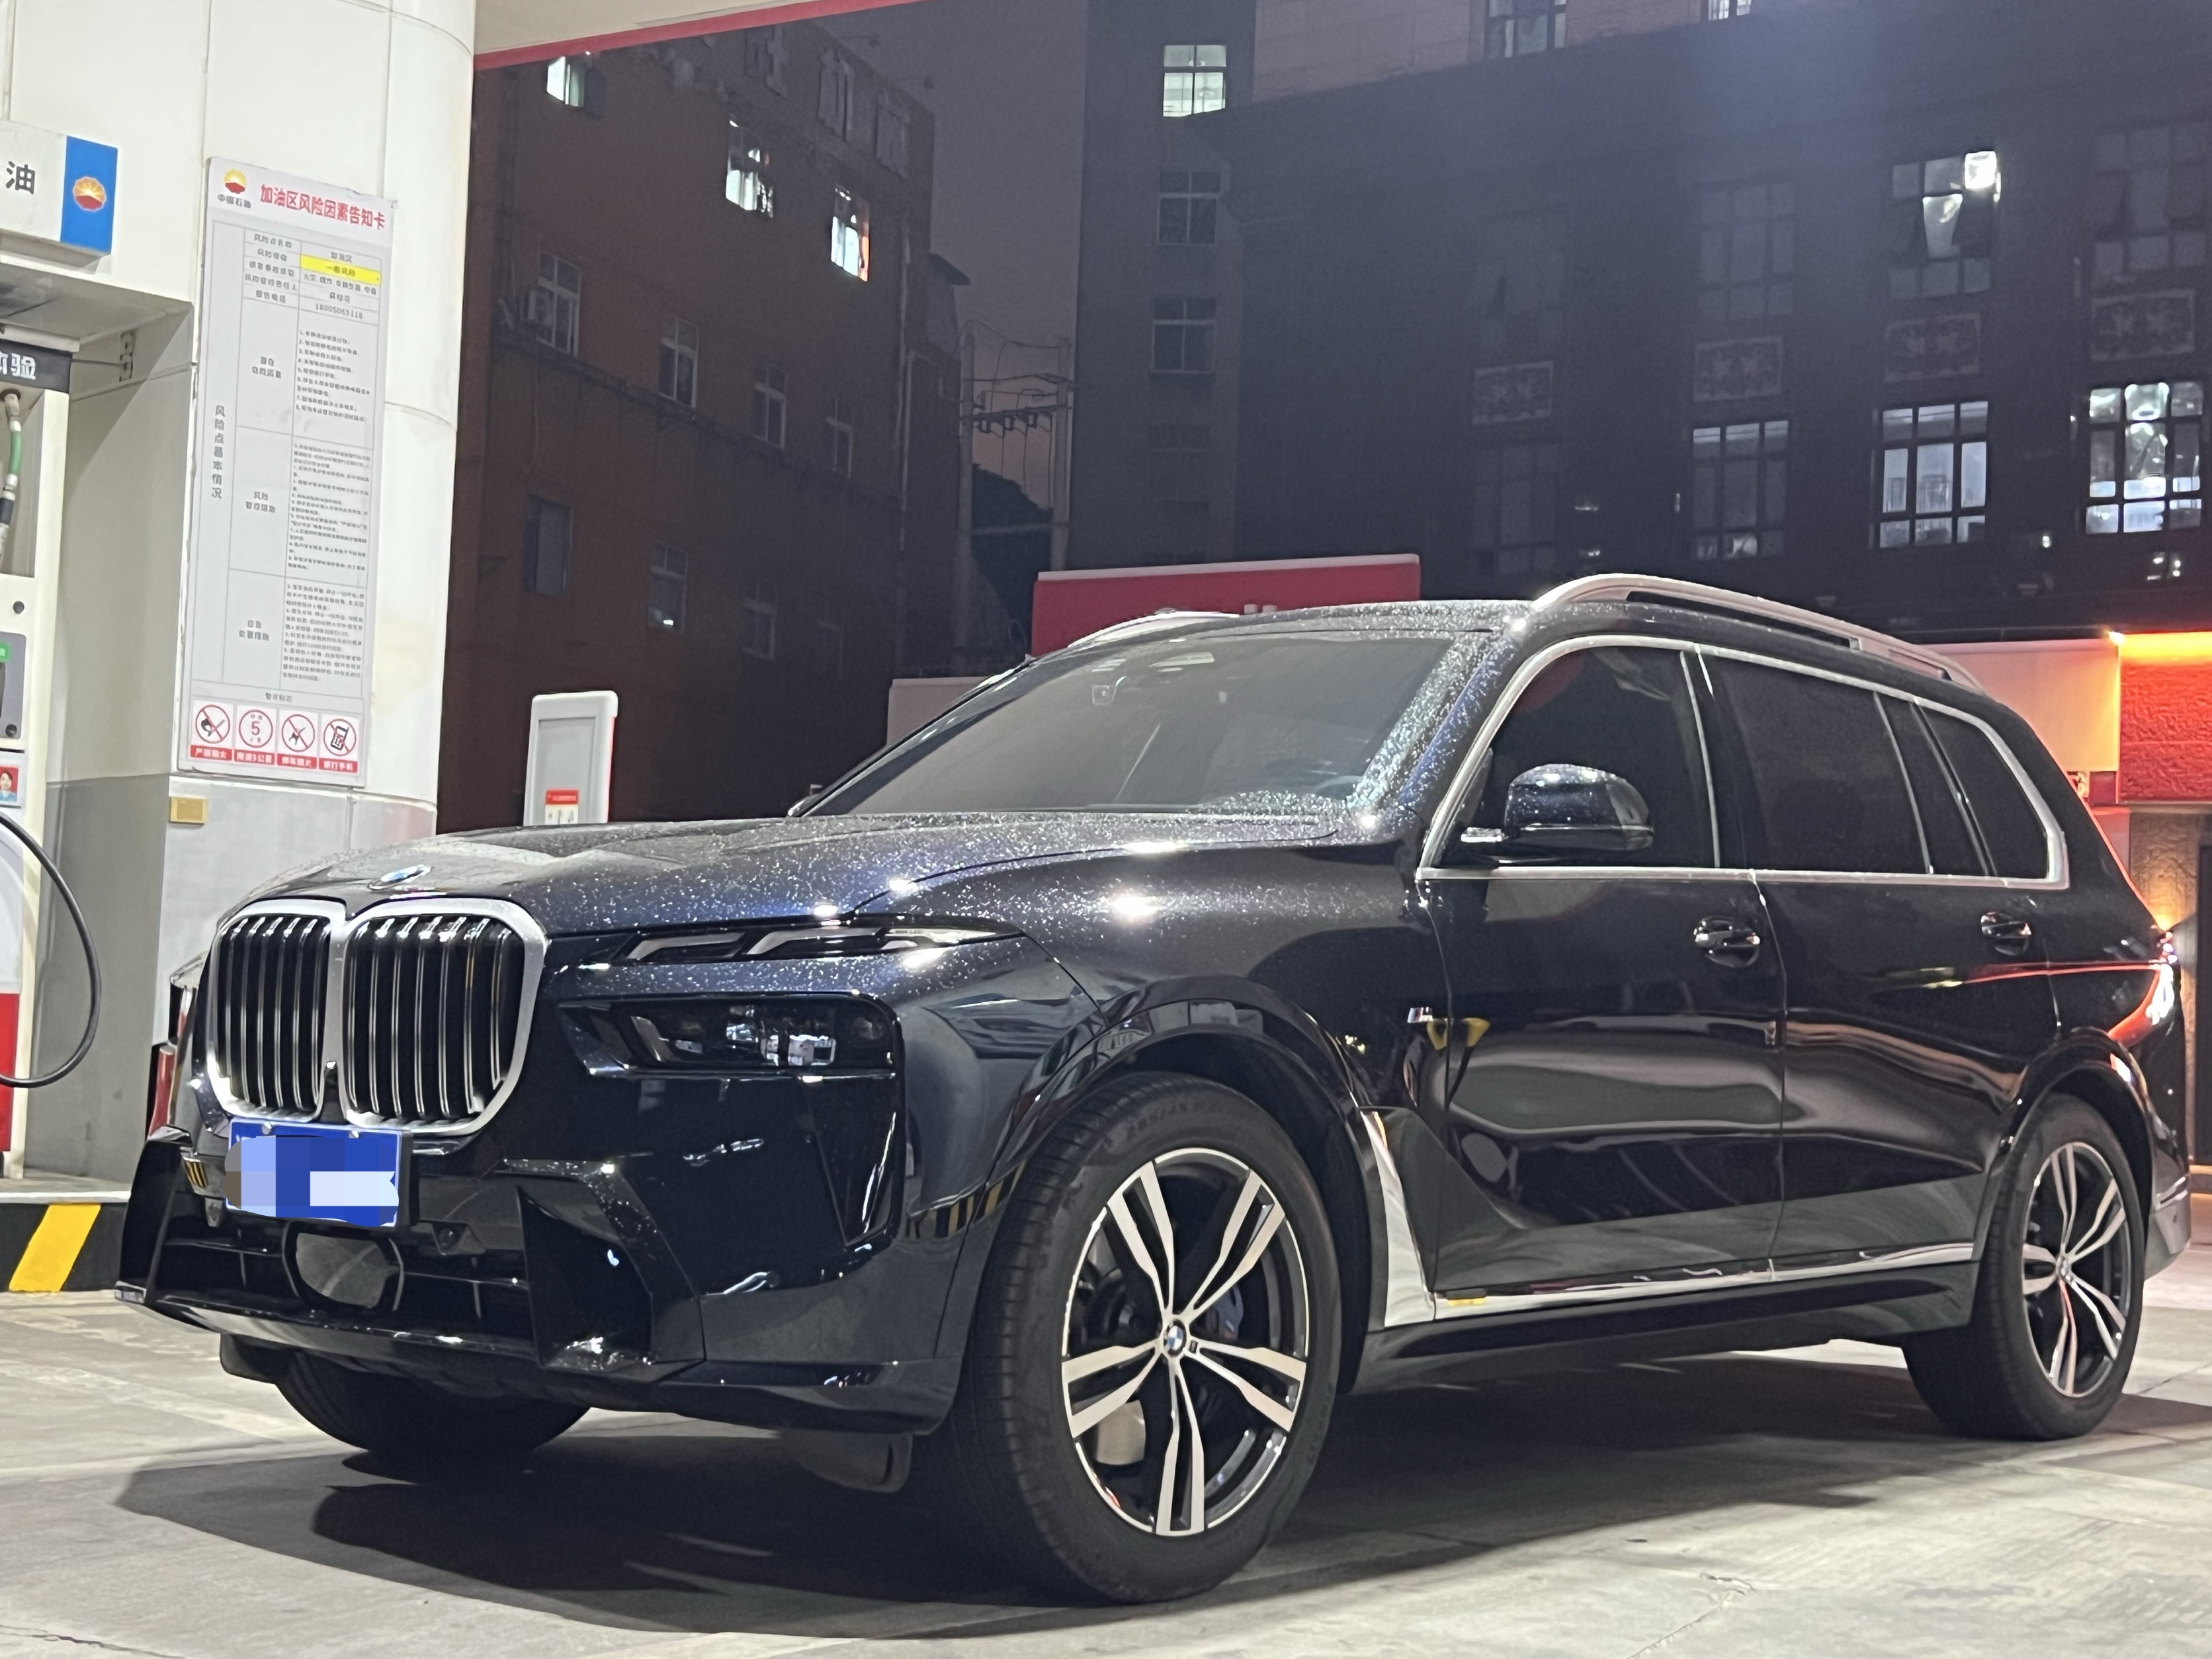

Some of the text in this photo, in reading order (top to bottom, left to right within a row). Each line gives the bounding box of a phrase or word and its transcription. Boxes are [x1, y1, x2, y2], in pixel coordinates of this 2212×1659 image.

[6, 161, 36, 195] 油
[260, 183, 385, 230] 加油区风险因素告知卡
[251, 721, 260, 736] 5
